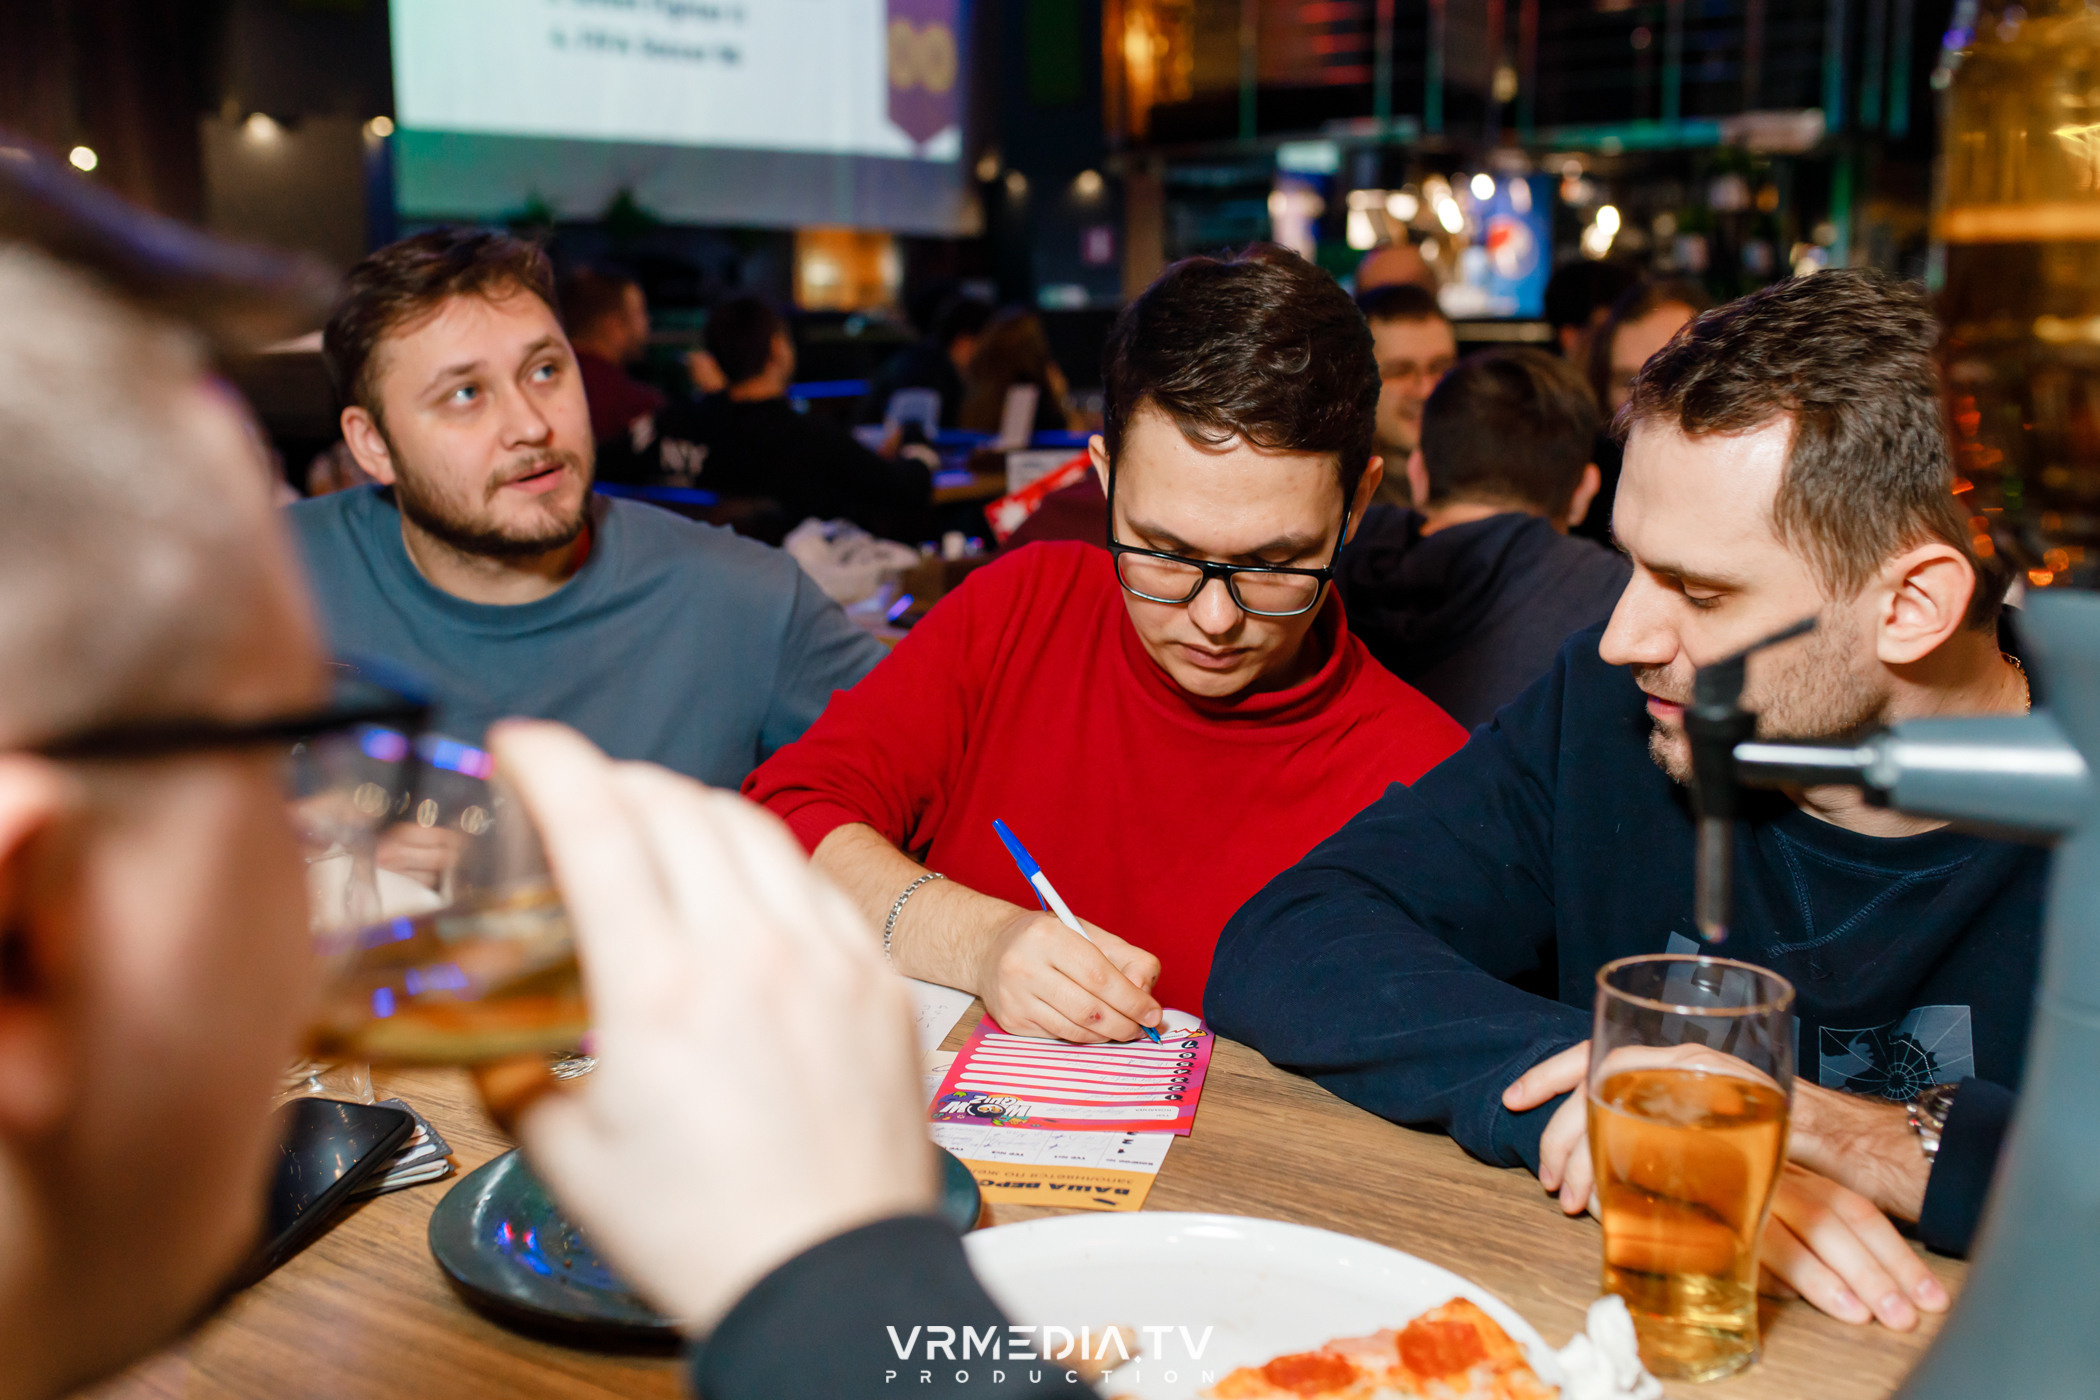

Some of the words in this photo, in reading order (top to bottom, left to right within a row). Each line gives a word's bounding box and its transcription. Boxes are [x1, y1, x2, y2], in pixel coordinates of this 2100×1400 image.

[971, 1095, 1017, 1105] QUIZ
[978, 1180, 1041, 1188] ВЕРС
[1048, 1183, 1130, 1195] ВАША
